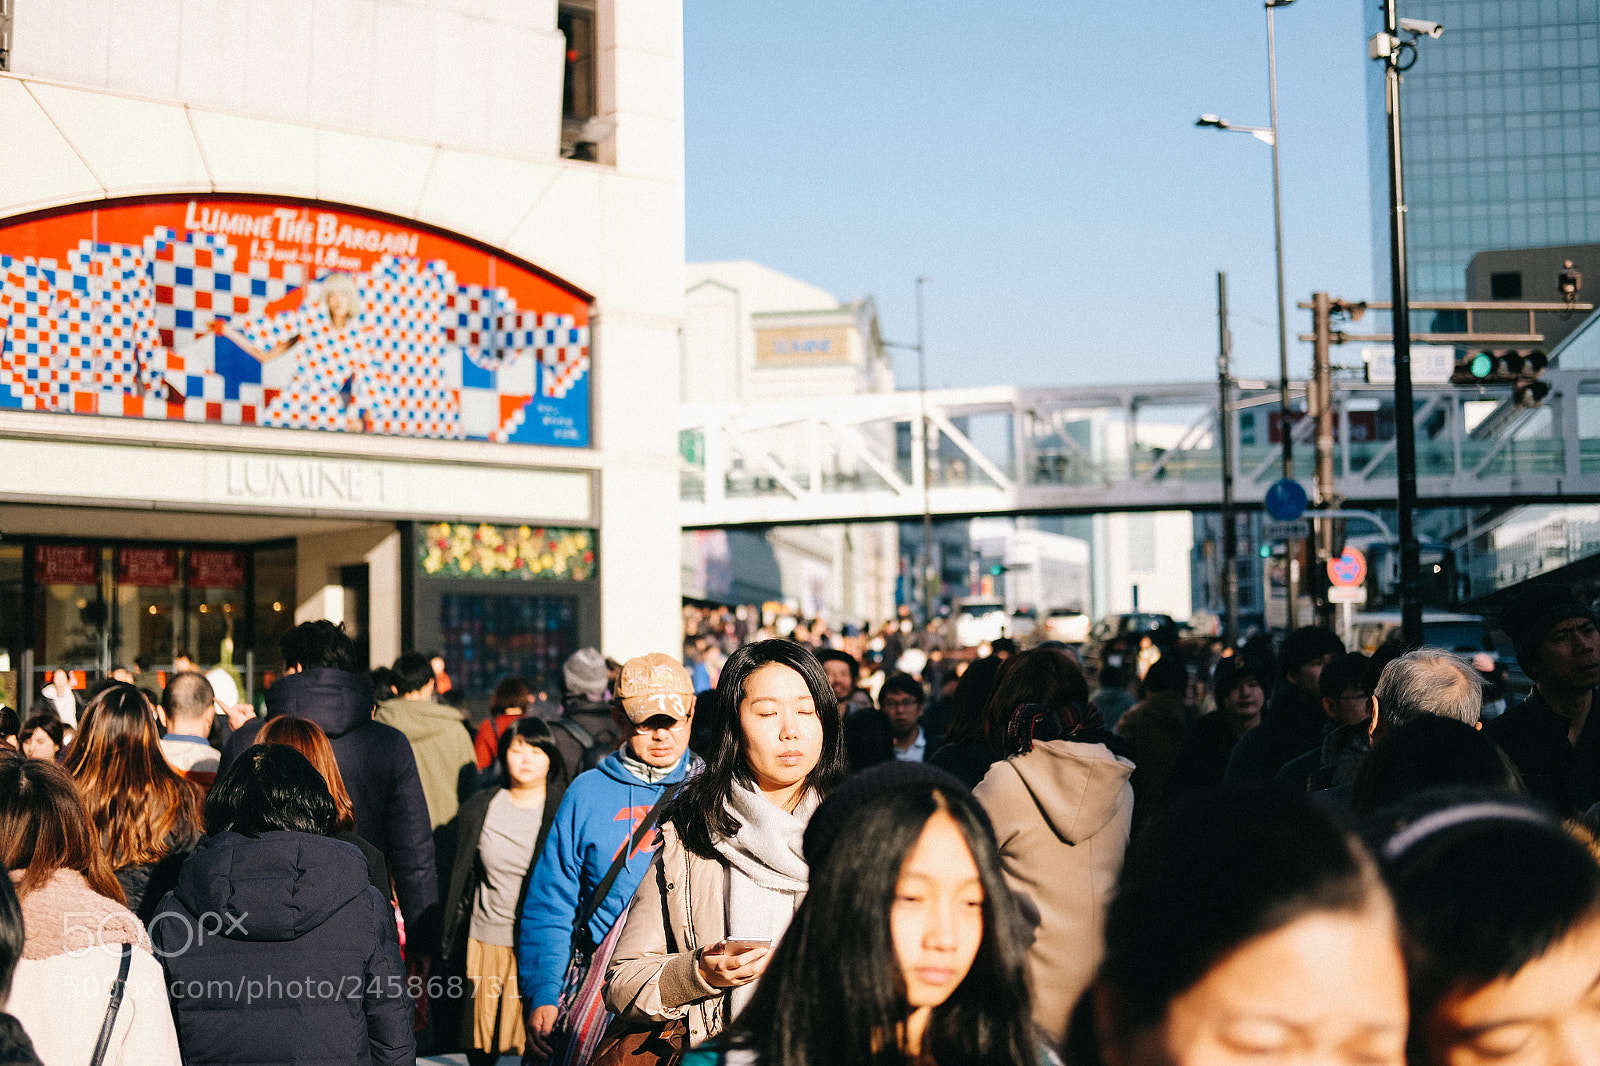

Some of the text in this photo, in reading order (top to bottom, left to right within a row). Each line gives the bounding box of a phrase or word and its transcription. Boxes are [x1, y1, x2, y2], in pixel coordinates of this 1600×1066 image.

[185, 201, 273, 237] LUMINE
[273, 208, 315, 244] THE
[316, 213, 419, 255] BARGAIN
[227, 459, 363, 502] LUMINE
